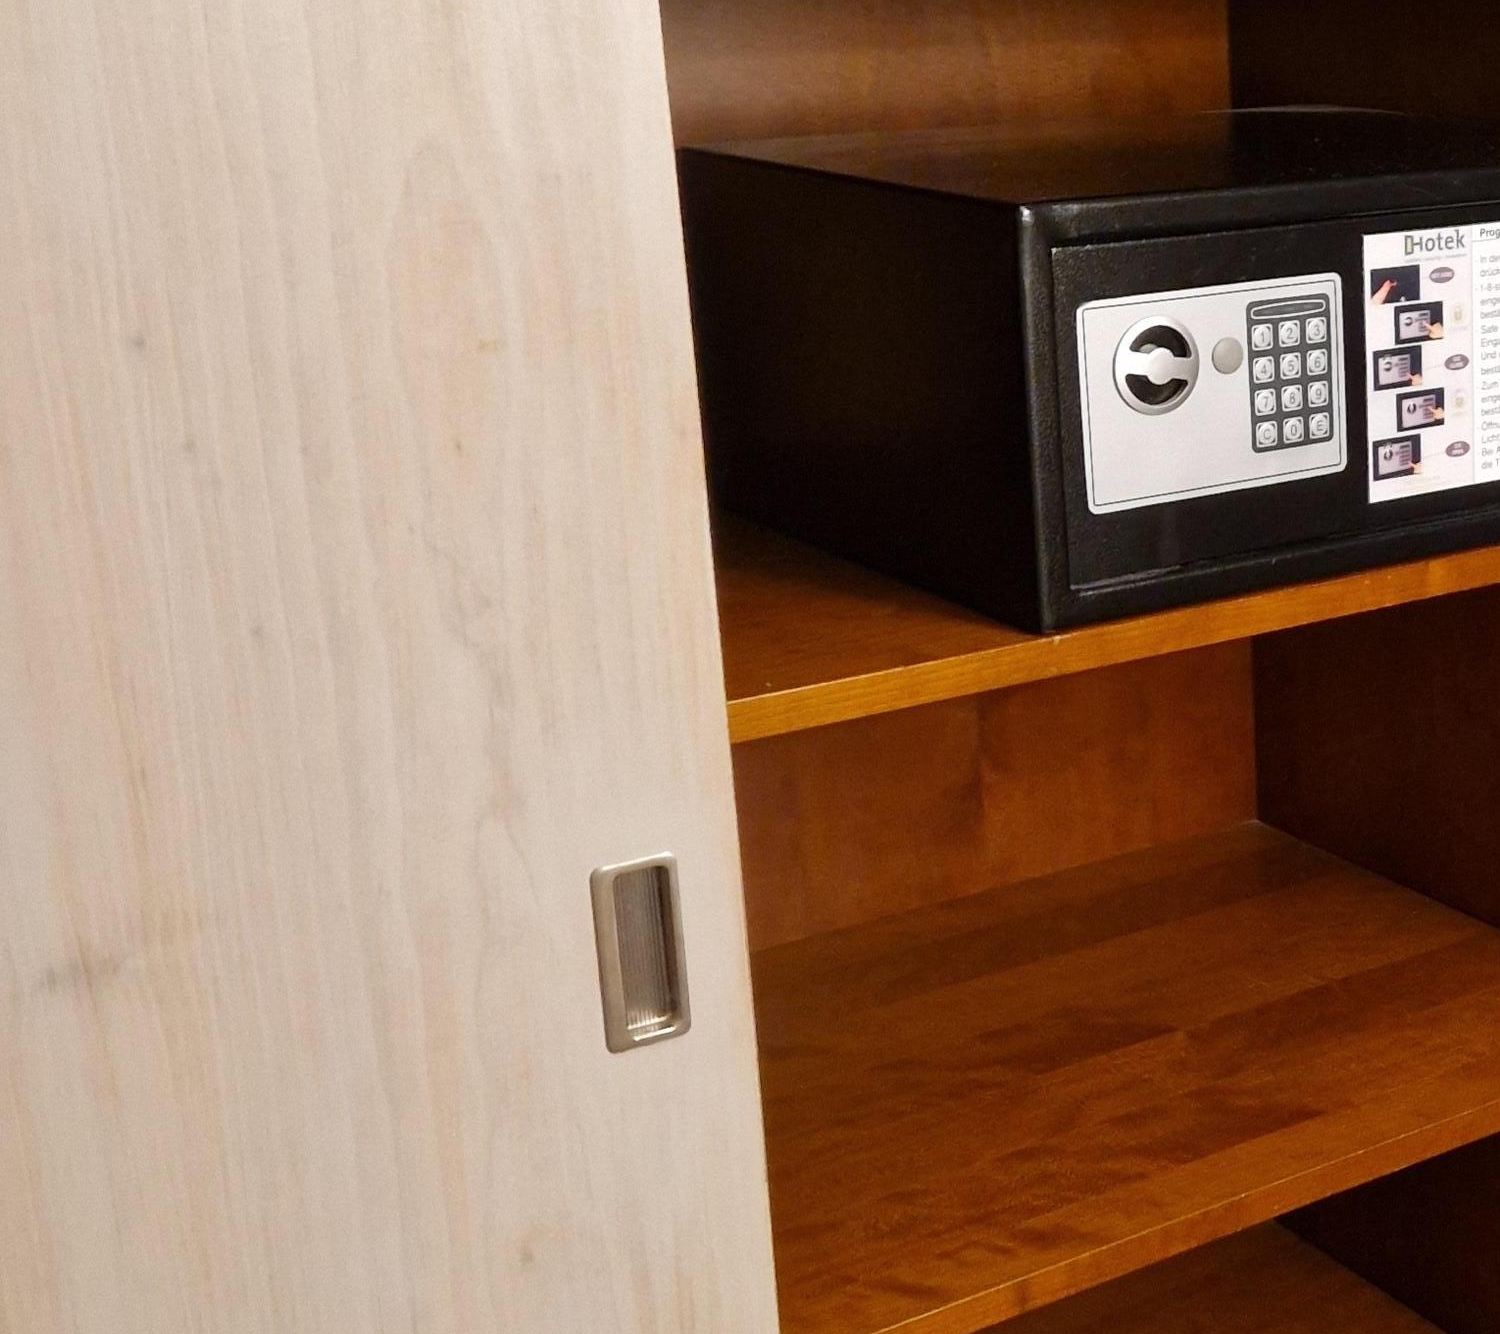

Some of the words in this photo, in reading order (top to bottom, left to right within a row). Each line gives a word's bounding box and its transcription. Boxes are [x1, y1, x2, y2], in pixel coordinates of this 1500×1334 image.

[1404, 229, 1466, 256] Hotek
[1259, 330, 1265, 344] 1
[1285, 327, 1294, 340] 2
[1313, 323, 1321, 337] 3
[1259, 363, 1269, 376] 4
[1287, 360, 1295, 373] 5
[1313, 355, 1322, 369] 6
[1262, 395, 1270, 409] 7
[1289, 392, 1296, 406] 8
[1315, 388, 1323, 401] 9
[1262, 428, 1271, 441] C
[1316, 419, 1324, 432] E
